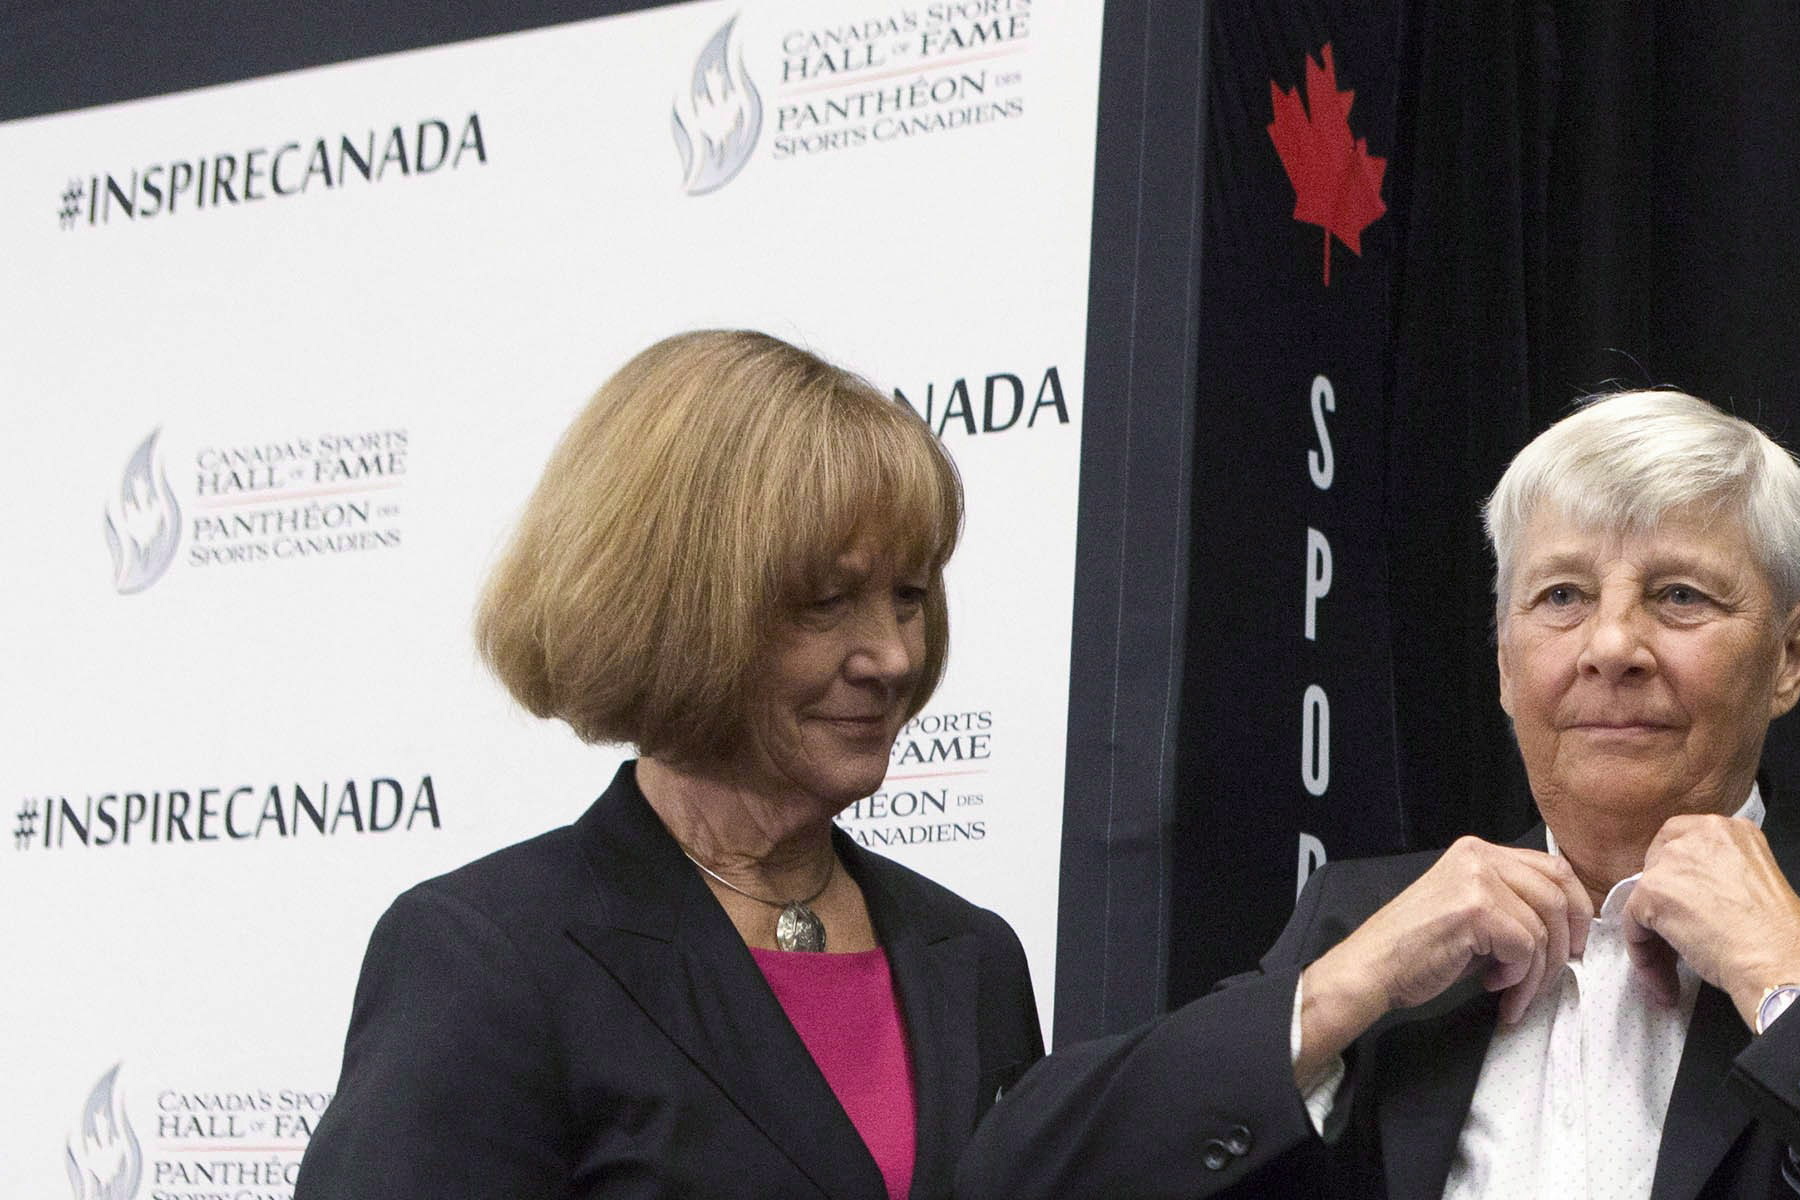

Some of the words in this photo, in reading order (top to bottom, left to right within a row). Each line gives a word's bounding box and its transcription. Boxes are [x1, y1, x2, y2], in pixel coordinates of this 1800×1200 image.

[782, 43, 886, 83] HALL
[920, 16, 1030, 55] FAME
[777, 71, 988, 132] PANTHÉON
[774, 127, 867, 159] SPORTS
[872, 98, 1023, 142] CANADIENS
[57, 111, 488, 230] #INSPIRECANADA
[894, 366, 1070, 437] NADA
[319, 429, 408, 453] SPORTS
[197, 467, 283, 496] HALL
[313, 451, 407, 483] FAME
[193, 500, 371, 541] PANTHÉON
[188, 543, 270, 568] SPORTS
[273, 530, 401, 557] CANADIENS
[904, 711, 992, 736] PORTS
[14, 774, 441, 850] #INSPIRECANADA
[957, 794, 984, 807] DES
[157, 1115, 246, 1138] HALL
[273, 1114, 322, 1138] FA
[153, 1156, 301, 1186] PANTHÉO
